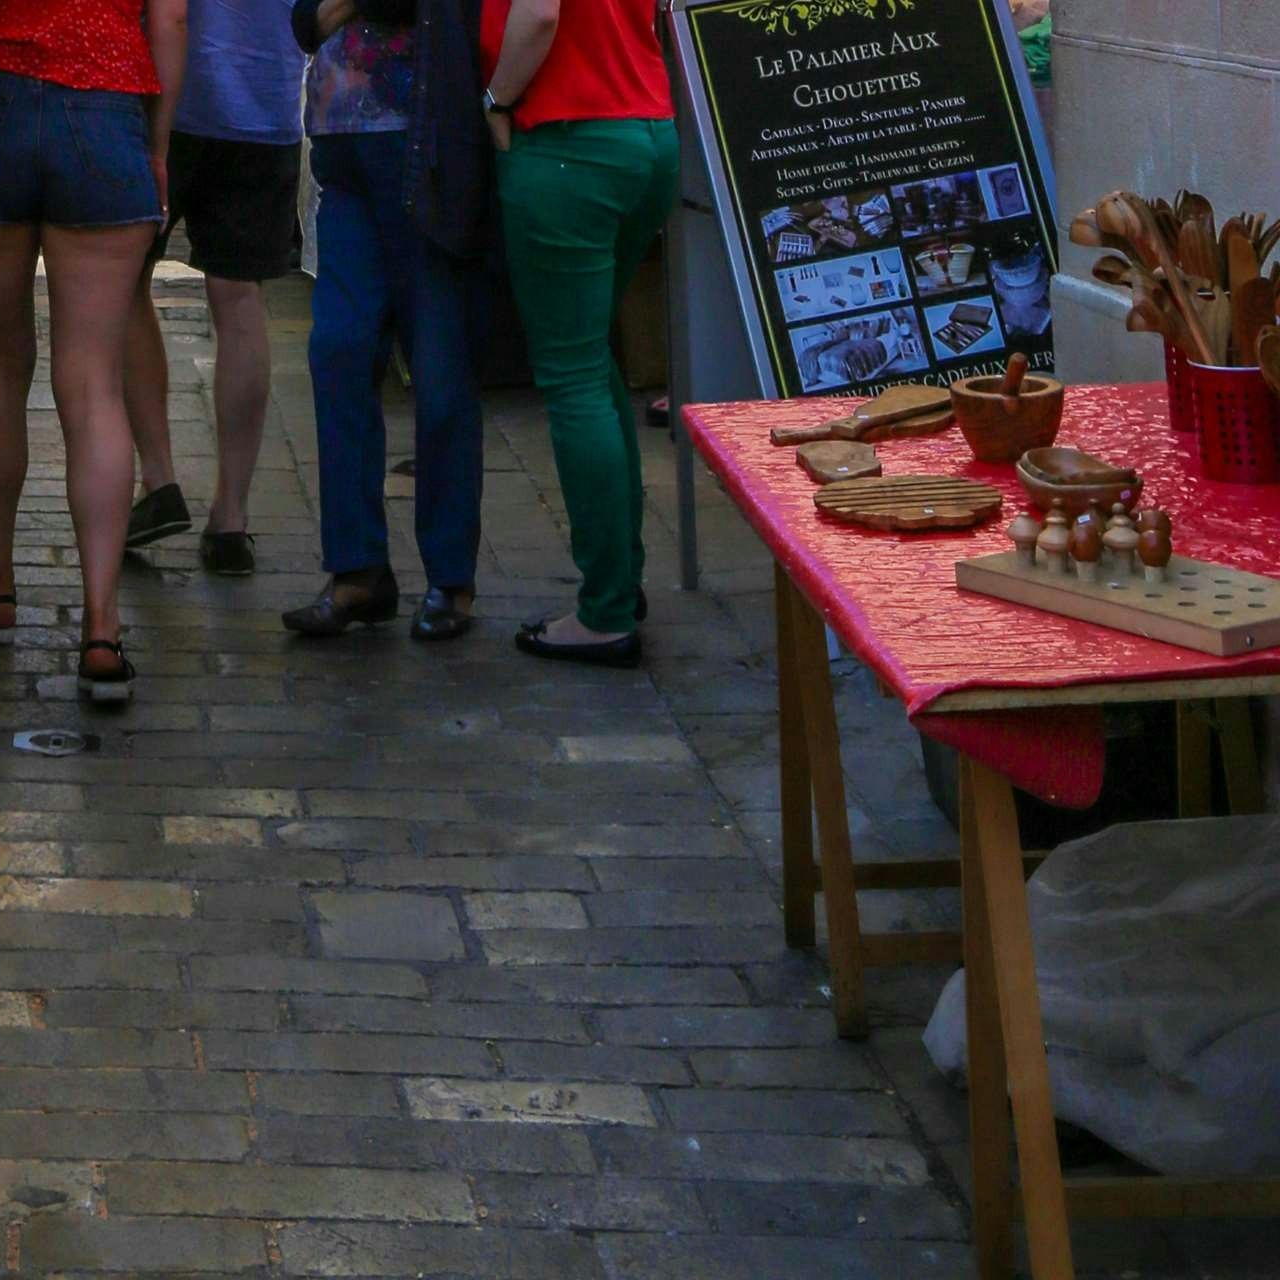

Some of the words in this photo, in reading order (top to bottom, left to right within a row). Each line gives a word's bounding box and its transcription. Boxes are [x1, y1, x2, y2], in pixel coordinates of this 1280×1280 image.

[755, 55, 786, 79] LE
[787, 40, 885, 73] PALMIER
[889, 31, 942, 56] AUX
[793, 71, 921, 108] CHOUETTES
[751, 142, 819, 161] ARTISANAUX
[827, 134, 855, 146] ARTS
[856, 132, 870, 142] DE
[872, 129, 885, 139] LA
[887, 123, 918, 136] TABLE
[924, 115, 962, 129] PLAIDS
[761, 124, 815, 141] CADEAUX
[861, 107, 914, 122] SENTEURS
[921, 96, 966, 112] PANIERS
[776, 167, 811, 181] HOME
[855, 147, 918, 167] HANDMADE
[920, 140, 960, 154] BASKETS
[776, 184, 816, 198] SCENTS
[822, 177, 854, 190] GIFTS
[860, 164, 920, 183] TABLEWARE
[928, 154, 975, 170] GUZZINI
